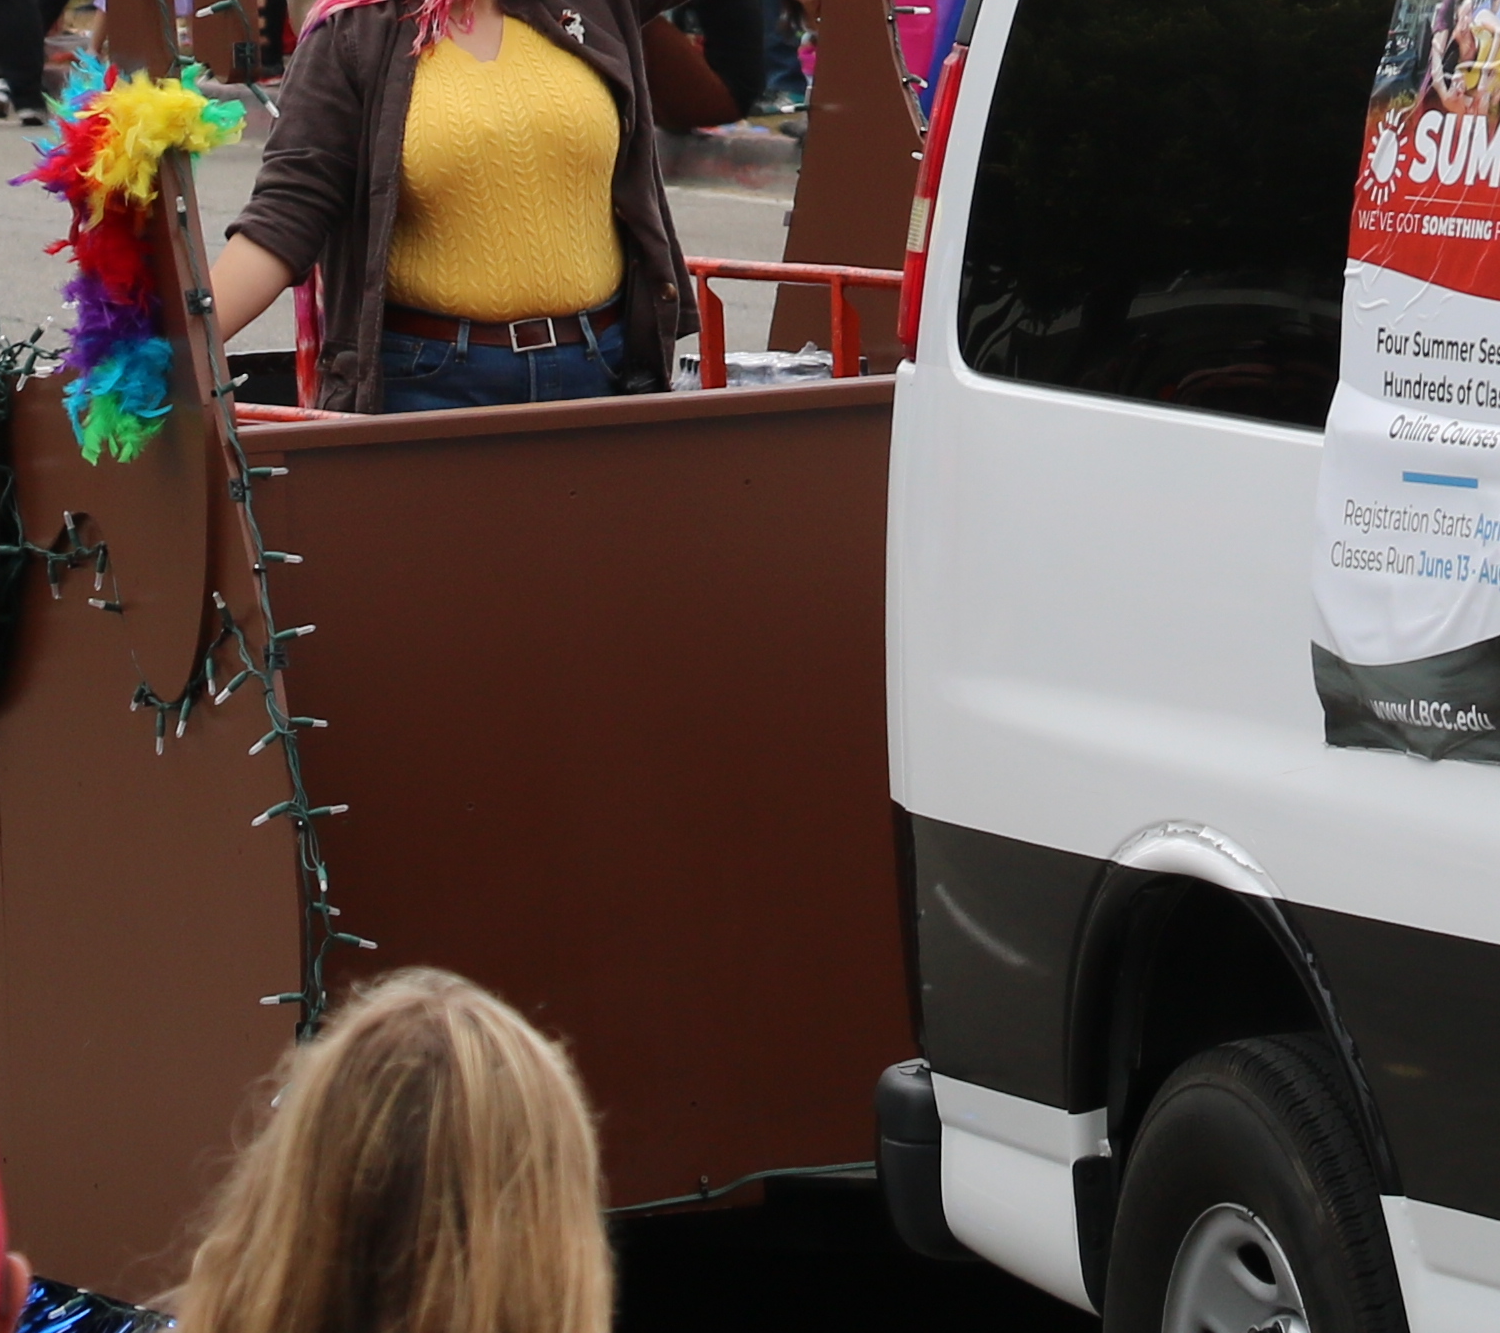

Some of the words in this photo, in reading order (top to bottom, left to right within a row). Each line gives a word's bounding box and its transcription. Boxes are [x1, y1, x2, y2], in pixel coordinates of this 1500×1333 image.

[1358, 209, 1393, 232] WE'VE
[1397, 212, 1422, 234] GOT
[1421, 217, 1492, 241] SOMETHING
[1377, 327, 1409, 356] Four
[1412, 331, 1475, 363] Summer
[1383, 371, 1453, 404] Hundreds
[1457, 378, 1473, 406] of
[1389, 414, 1441, 443] Online
[1343, 498, 1430, 534] Registration
[1432, 507, 1473, 539] Starts
[1331, 540, 1382, 572] Classes
[1385, 546, 1415, 575] Run
[1417, 550, 1452, 580] June
[1456, 554, 1470, 581] 13
[1370, 698, 1496, 732] www.LBCC.edu
